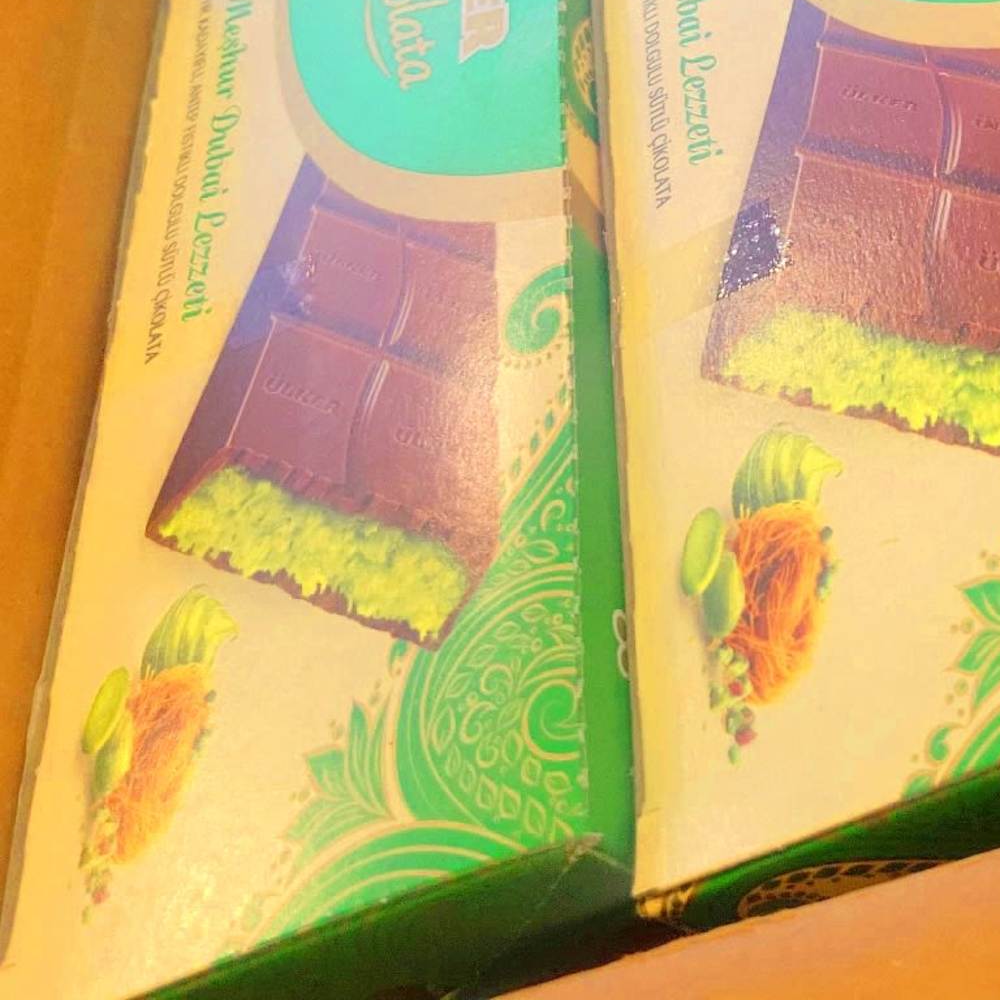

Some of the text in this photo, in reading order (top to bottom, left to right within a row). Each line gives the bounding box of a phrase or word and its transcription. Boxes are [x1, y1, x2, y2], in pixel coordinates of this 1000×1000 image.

[643, 20, 663, 87] DOLGULU
[649, 86, 671, 132] SÜTLÜ
[680, 55, 724, 166] Lezzeti
[199, 104, 242, 201] Dubai
[648, 132, 672, 210] ÇİKOLATA
[181, 210, 227, 323] Lezzeti
[145, 287, 171, 366] ÇİKOLATA
